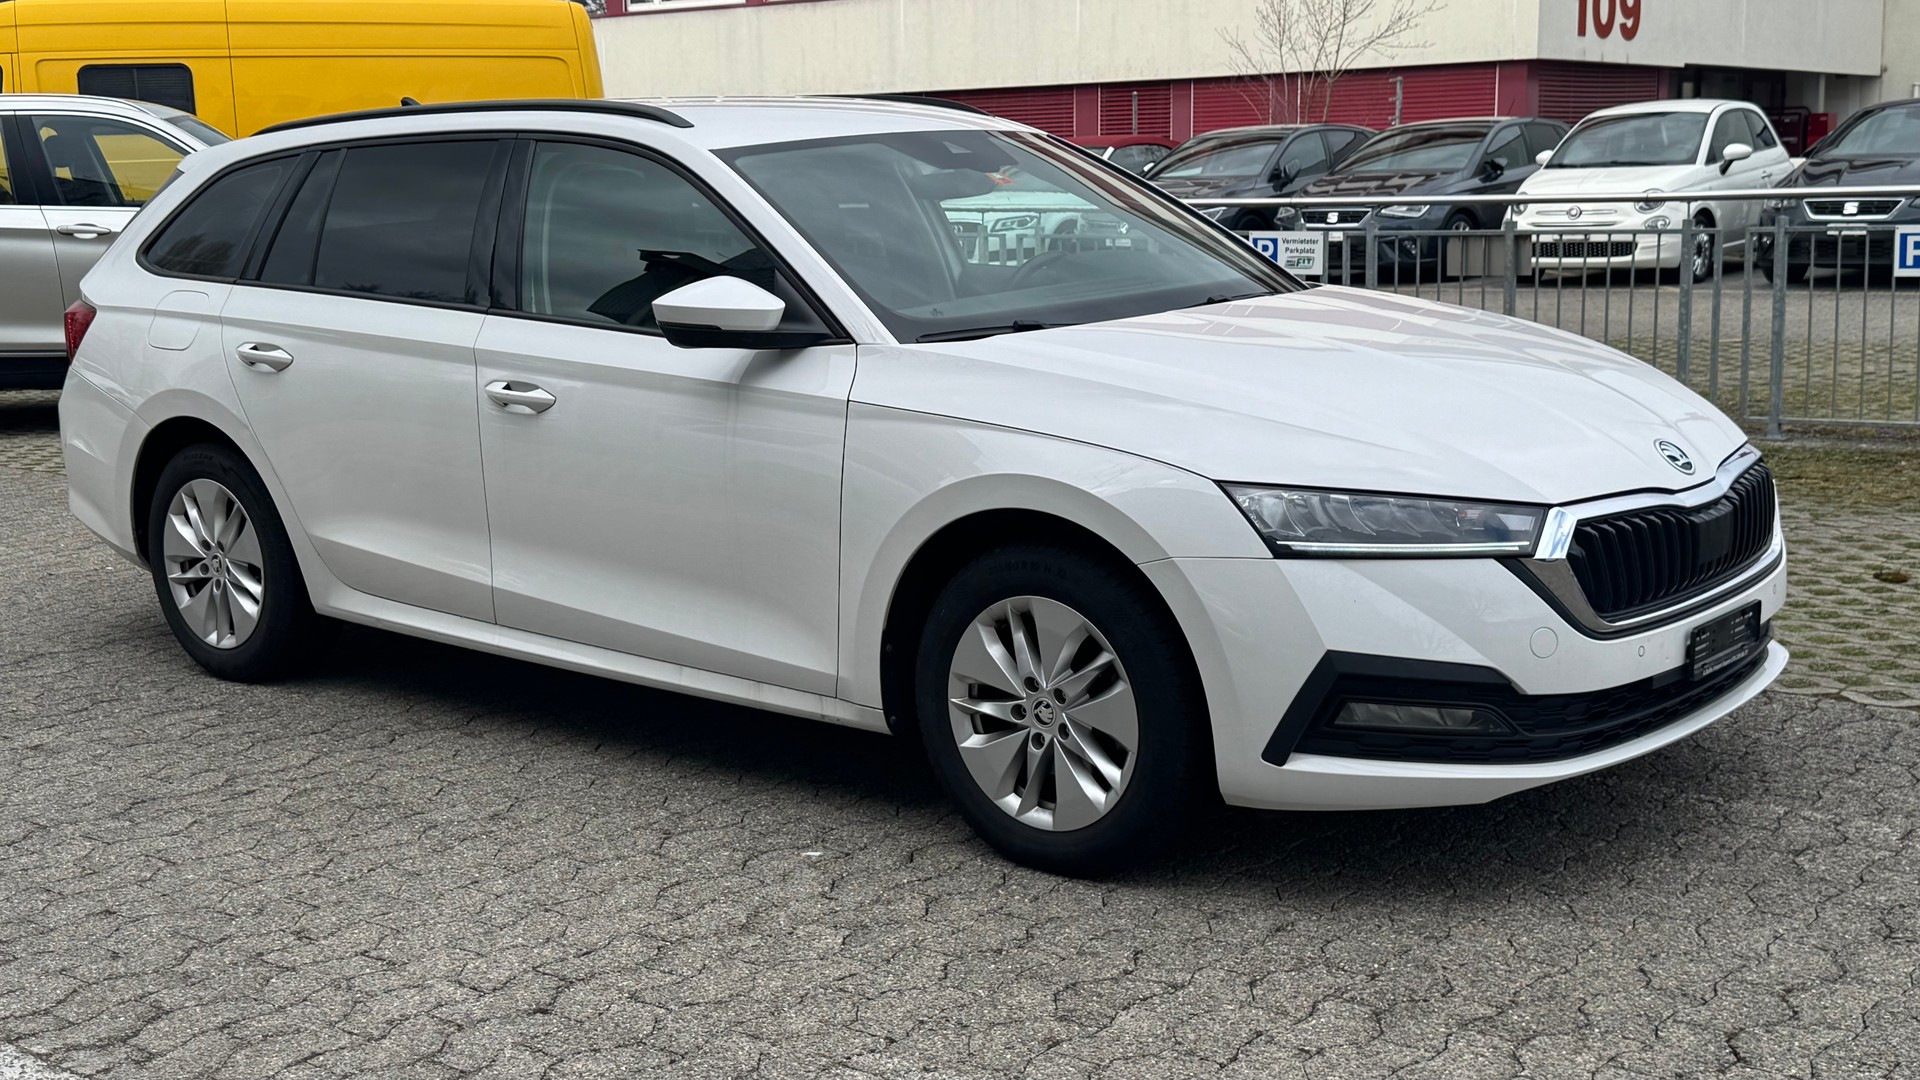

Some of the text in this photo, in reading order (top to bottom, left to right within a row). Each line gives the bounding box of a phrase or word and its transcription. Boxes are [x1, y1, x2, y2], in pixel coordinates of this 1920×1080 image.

[1577, 0, 1641, 41] 109
[1257, 240, 1274, 258] P
[1284, 247, 1315, 255] Parkplatz
[1296, 257, 1312, 267] FIT
